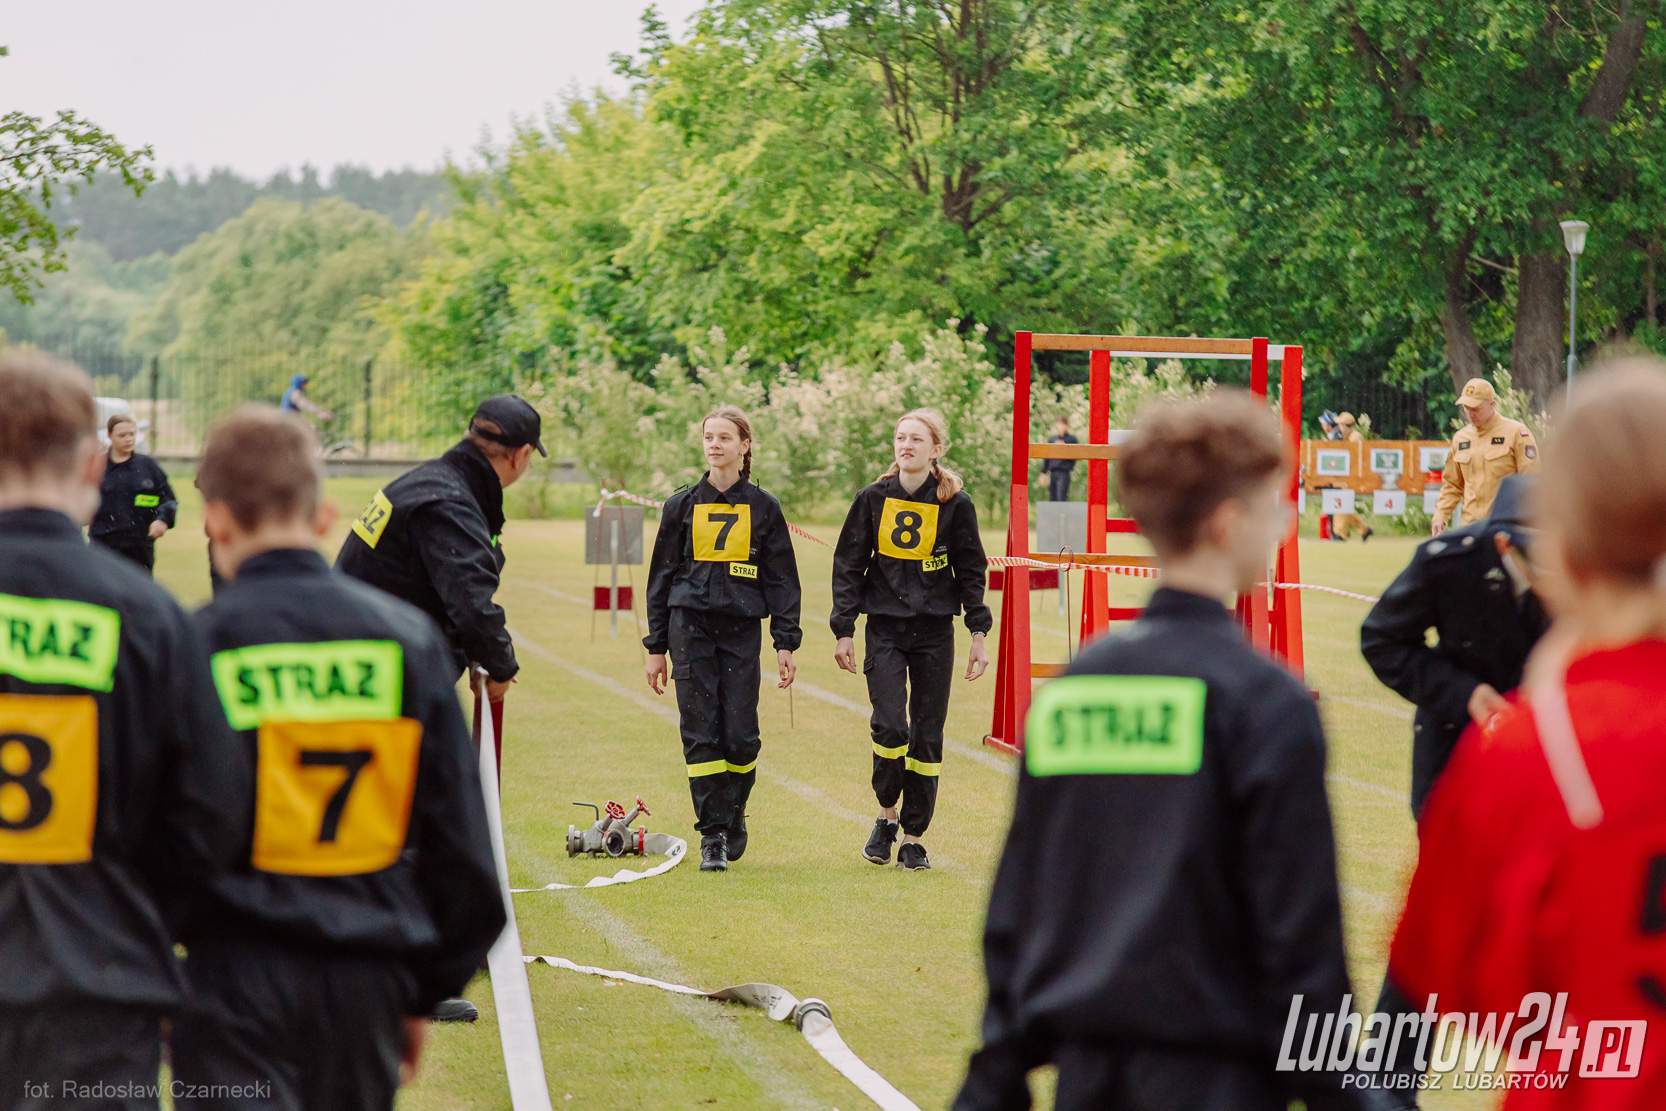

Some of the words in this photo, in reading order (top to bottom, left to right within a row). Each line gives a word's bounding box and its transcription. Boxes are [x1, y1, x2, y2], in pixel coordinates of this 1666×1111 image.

[708, 512, 739, 551] 7
[890, 510, 923, 550] 8
[0, 732, 55, 832] 8
[298, 748, 376, 843] 7
